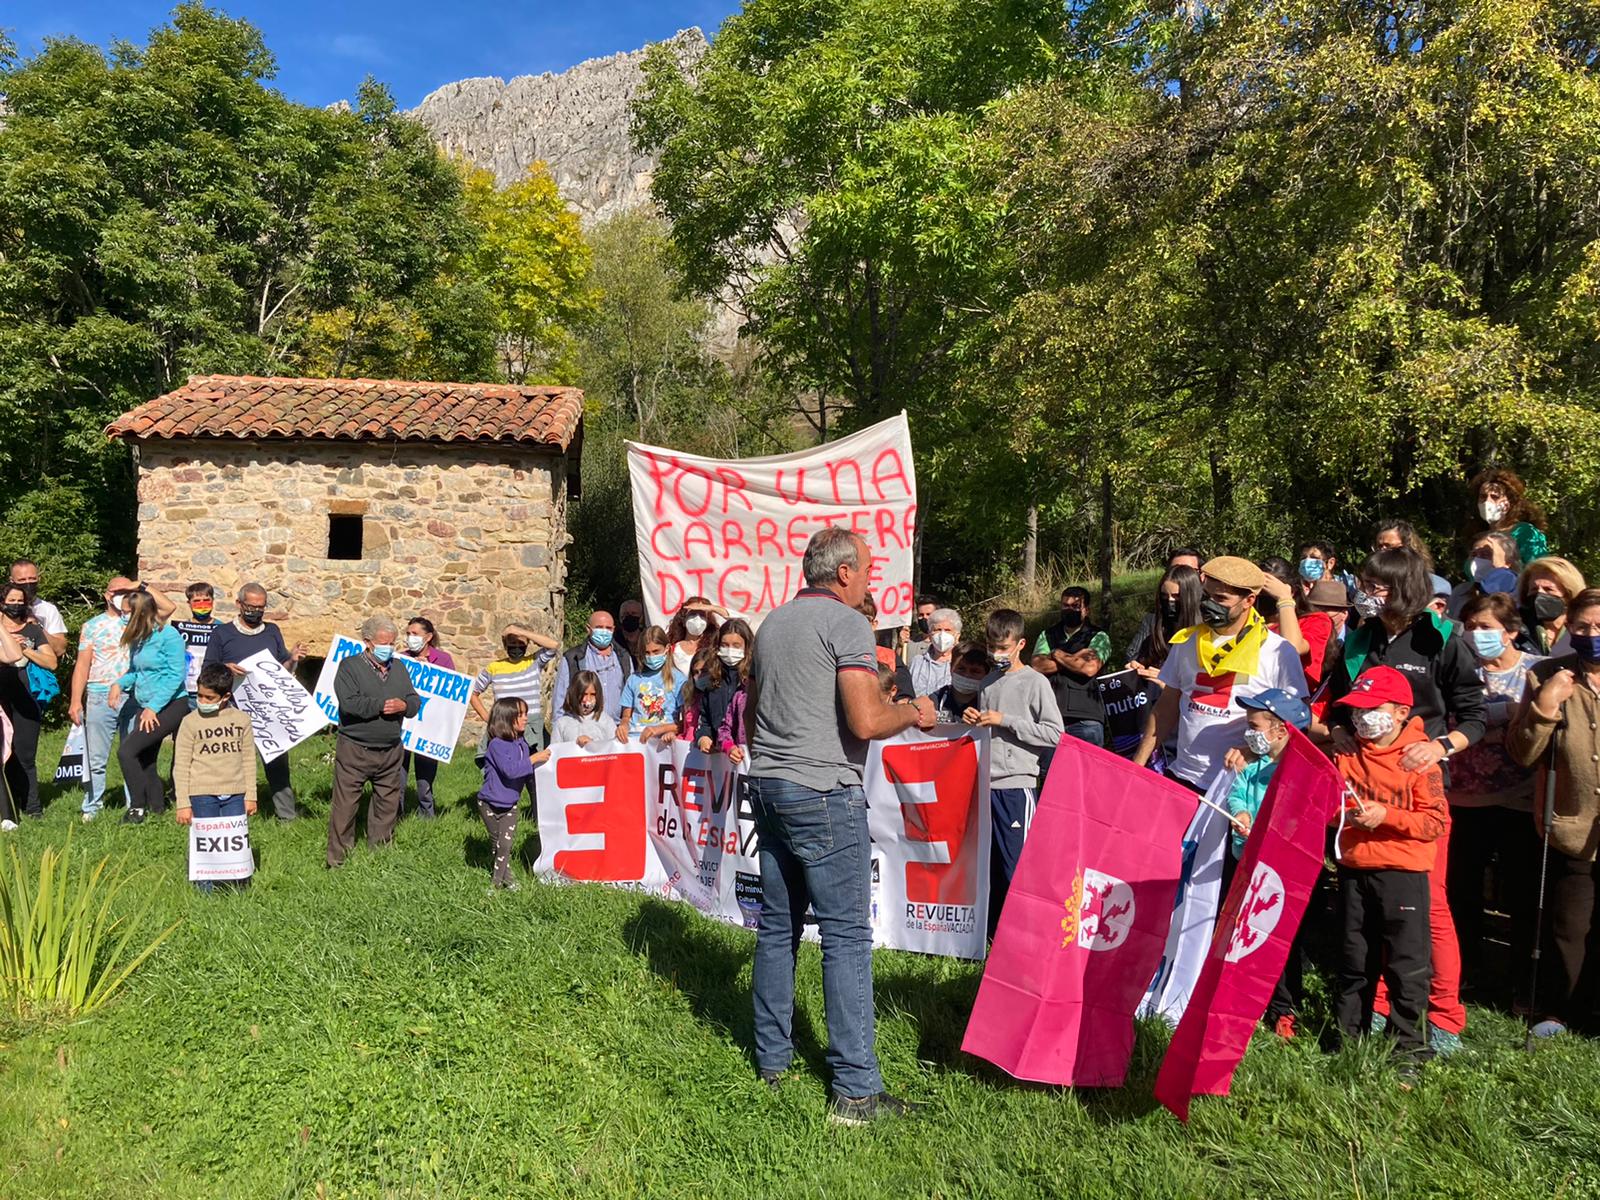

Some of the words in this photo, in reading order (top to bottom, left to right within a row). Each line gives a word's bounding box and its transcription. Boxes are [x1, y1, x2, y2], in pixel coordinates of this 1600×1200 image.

[656, 564, 803, 615] DIGN
[258, 684, 276, 699] de
[1106, 691, 1147, 716] nutos
[199, 730, 203, 740] I
[205, 723, 243, 739] DON'T
[199, 741, 242, 754] AGREE
[55, 765, 83, 778] OMB
[657, 809, 677, 838] de
[906, 904, 976, 923] REVUELTA
[906, 920, 915, 929] de
[916, 920, 922, 930] la
